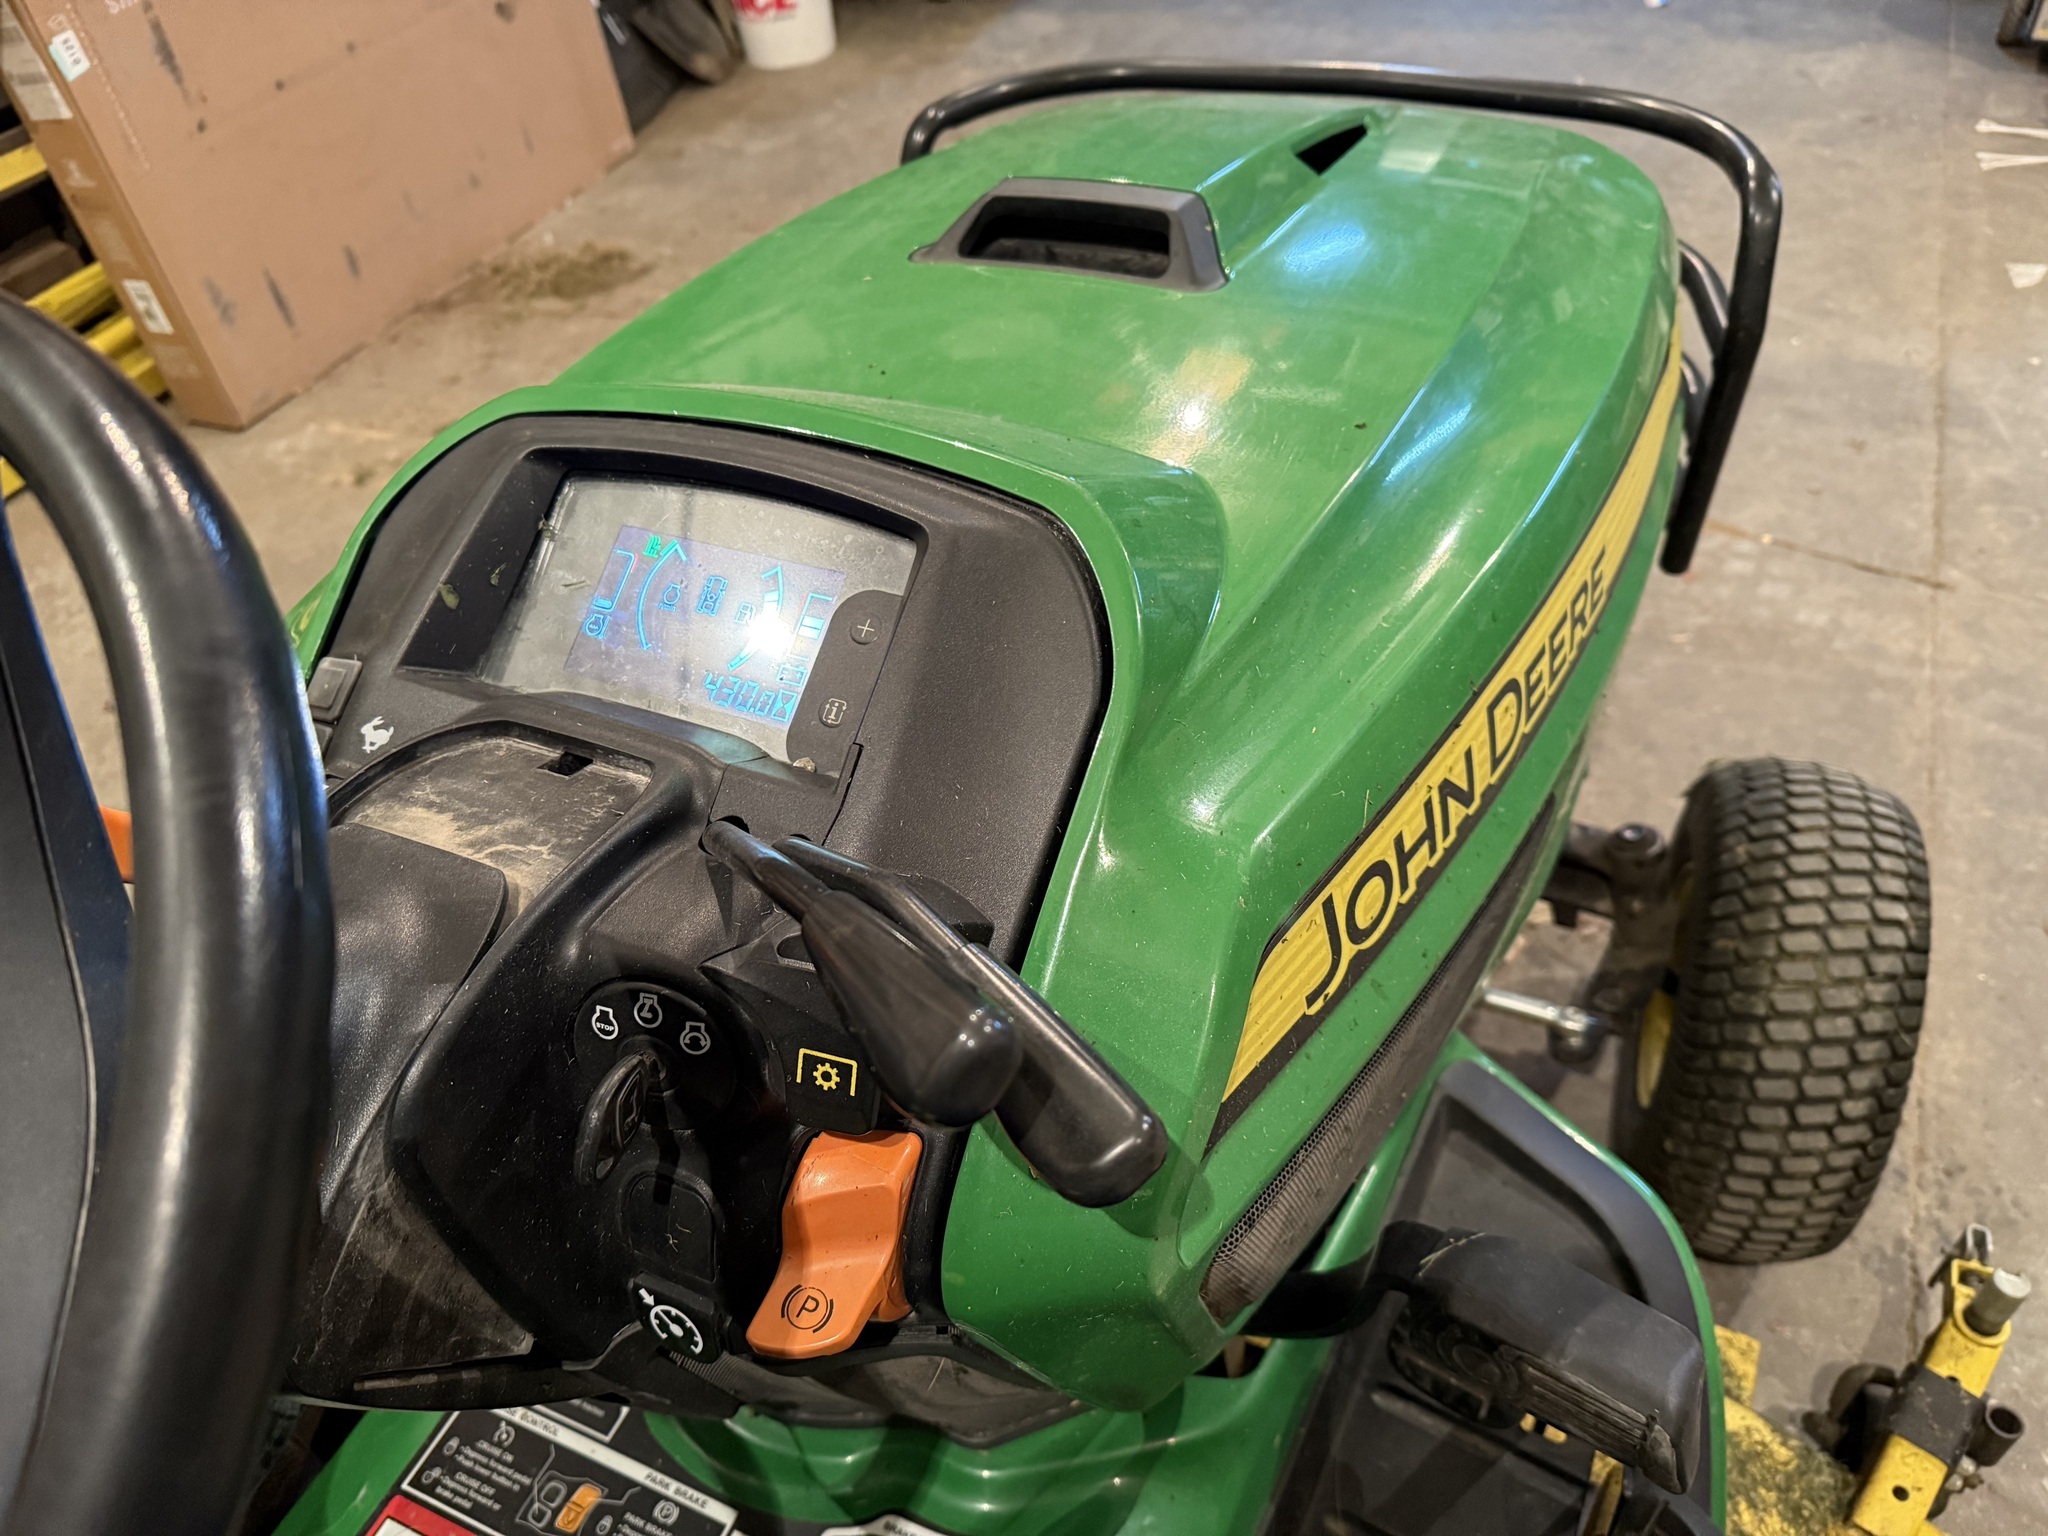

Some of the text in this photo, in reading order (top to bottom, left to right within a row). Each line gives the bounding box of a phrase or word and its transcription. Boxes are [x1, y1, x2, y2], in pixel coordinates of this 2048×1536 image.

[704, 672, 775, 716] 430.0
[1307, 547, 1607, 1006] JOHN DEERE
[596, 1021, 614, 1031] STOP
[475, 1439, 515, 1462] CRUISE ON
[454, 1471, 496, 1495] CRUISE OFF
[644, 1472, 708, 1509] PARK BRAKE
[623, 1512, 646, 1528] PARK
